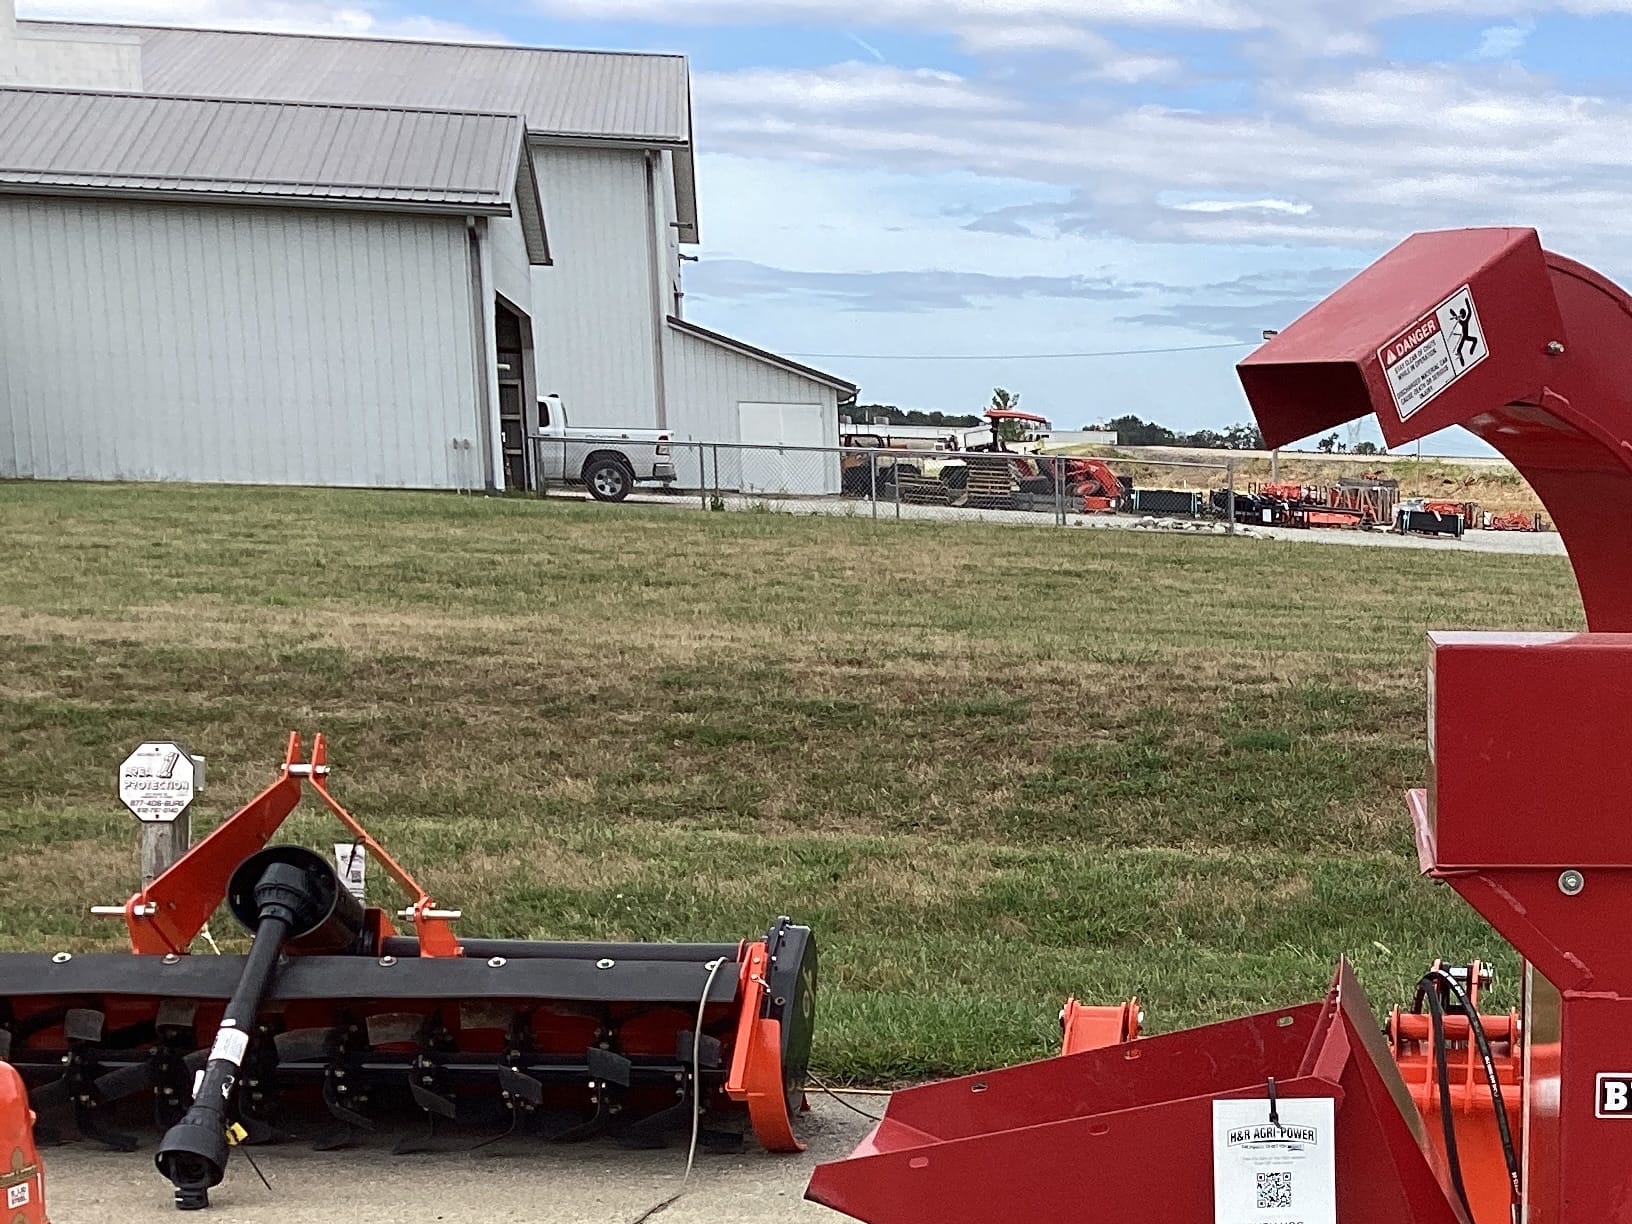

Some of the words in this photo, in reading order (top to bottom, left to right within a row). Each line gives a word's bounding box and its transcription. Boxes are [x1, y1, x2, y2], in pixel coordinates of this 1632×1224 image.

[1396, 319, 1437, 357] DANGER
[124, 781, 189, 790] PROTECTION
[1230, 1129, 1251, 1142] H&R
[1254, 1127, 1314, 1141] AGRI-POWER
